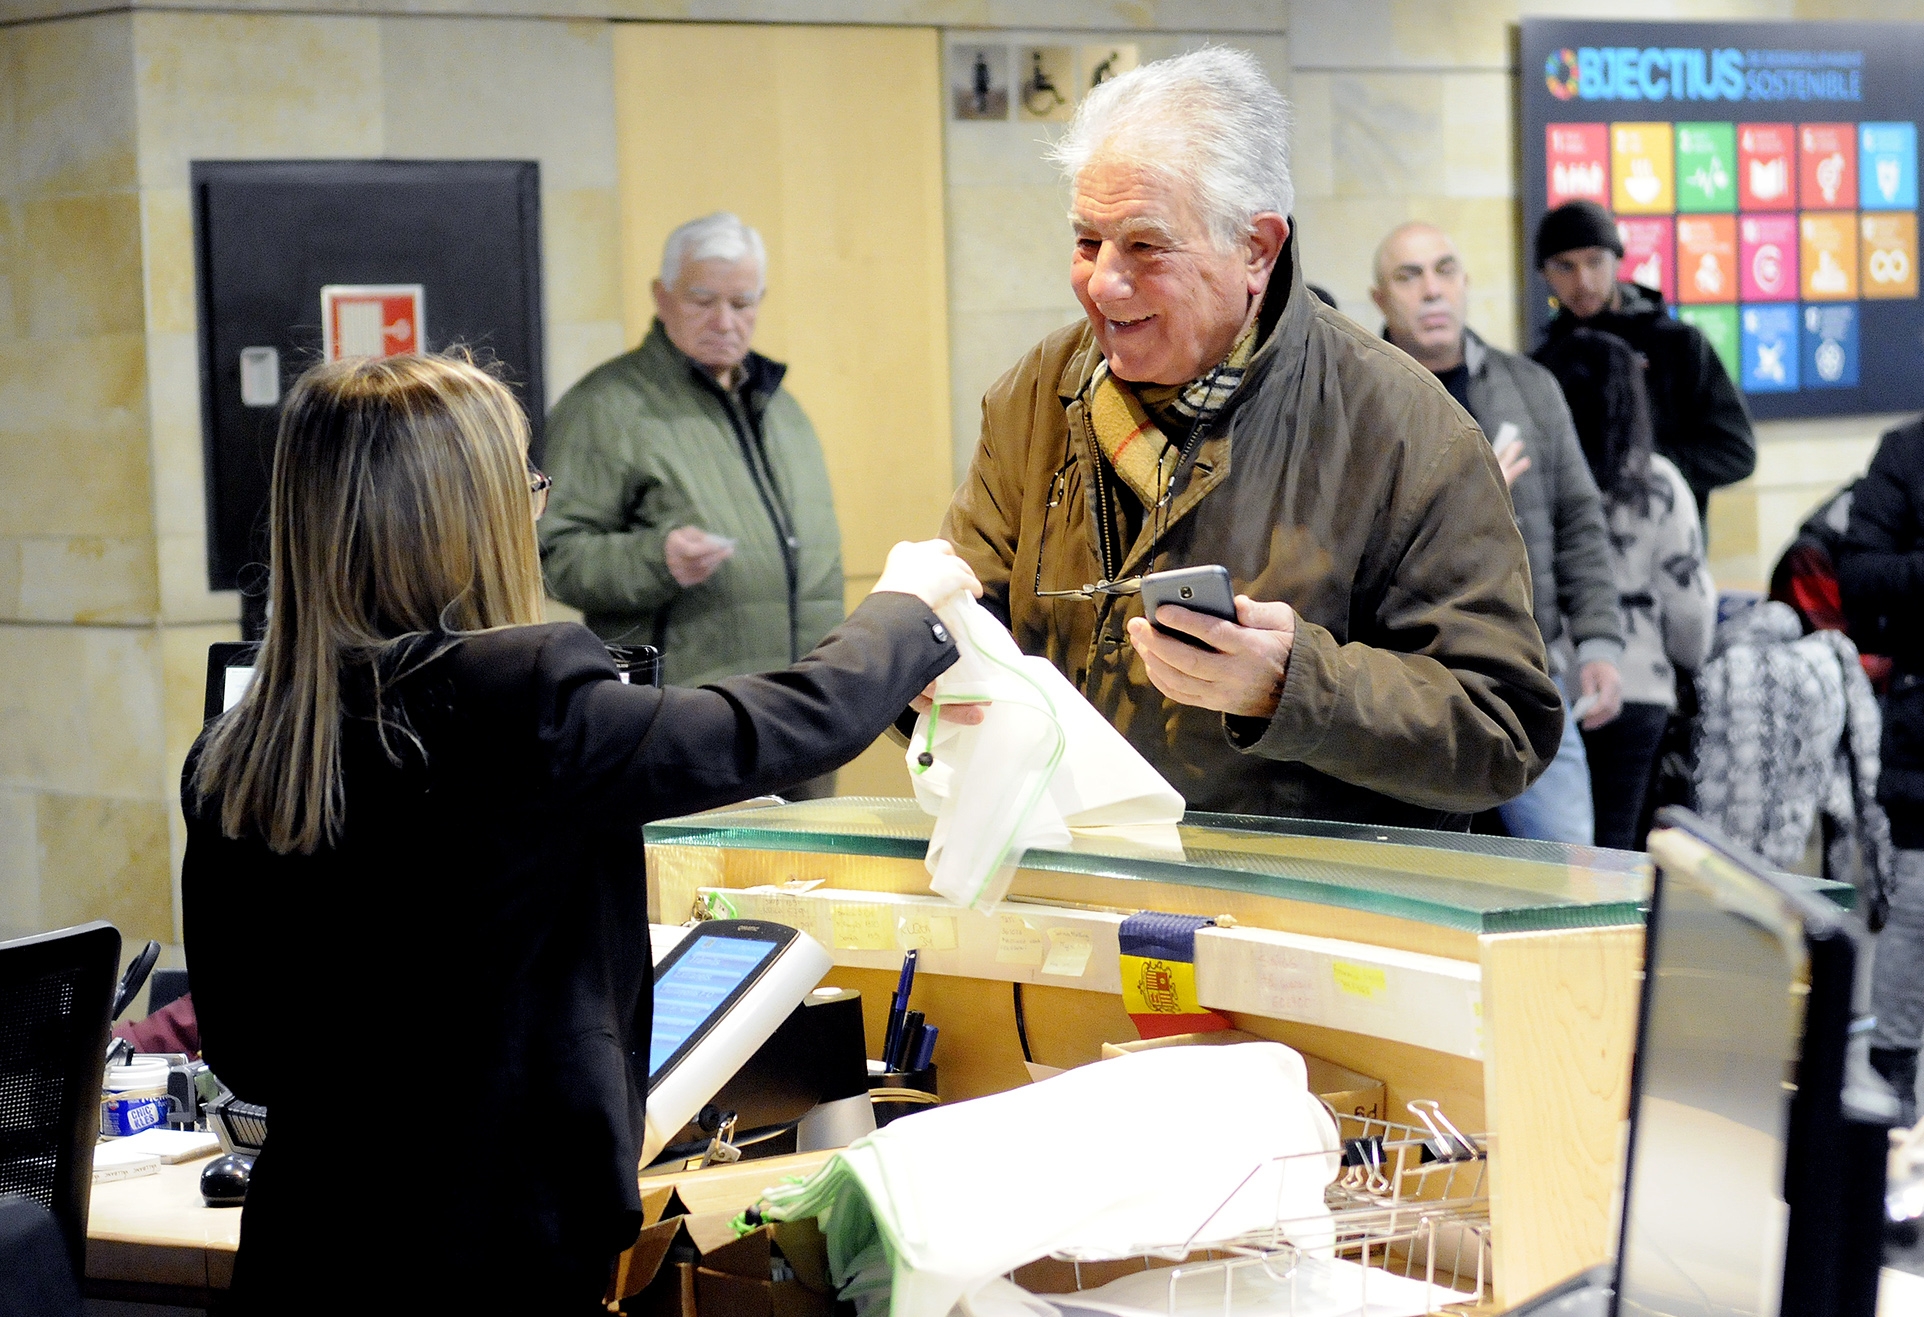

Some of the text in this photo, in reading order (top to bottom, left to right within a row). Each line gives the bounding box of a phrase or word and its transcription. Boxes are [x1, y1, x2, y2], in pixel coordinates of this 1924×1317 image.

[1746, 69, 1862, 100] SOSTENIBLE
[131, 1105, 153, 1119] CHIC-
[134, 1113, 155, 1128] KLES
